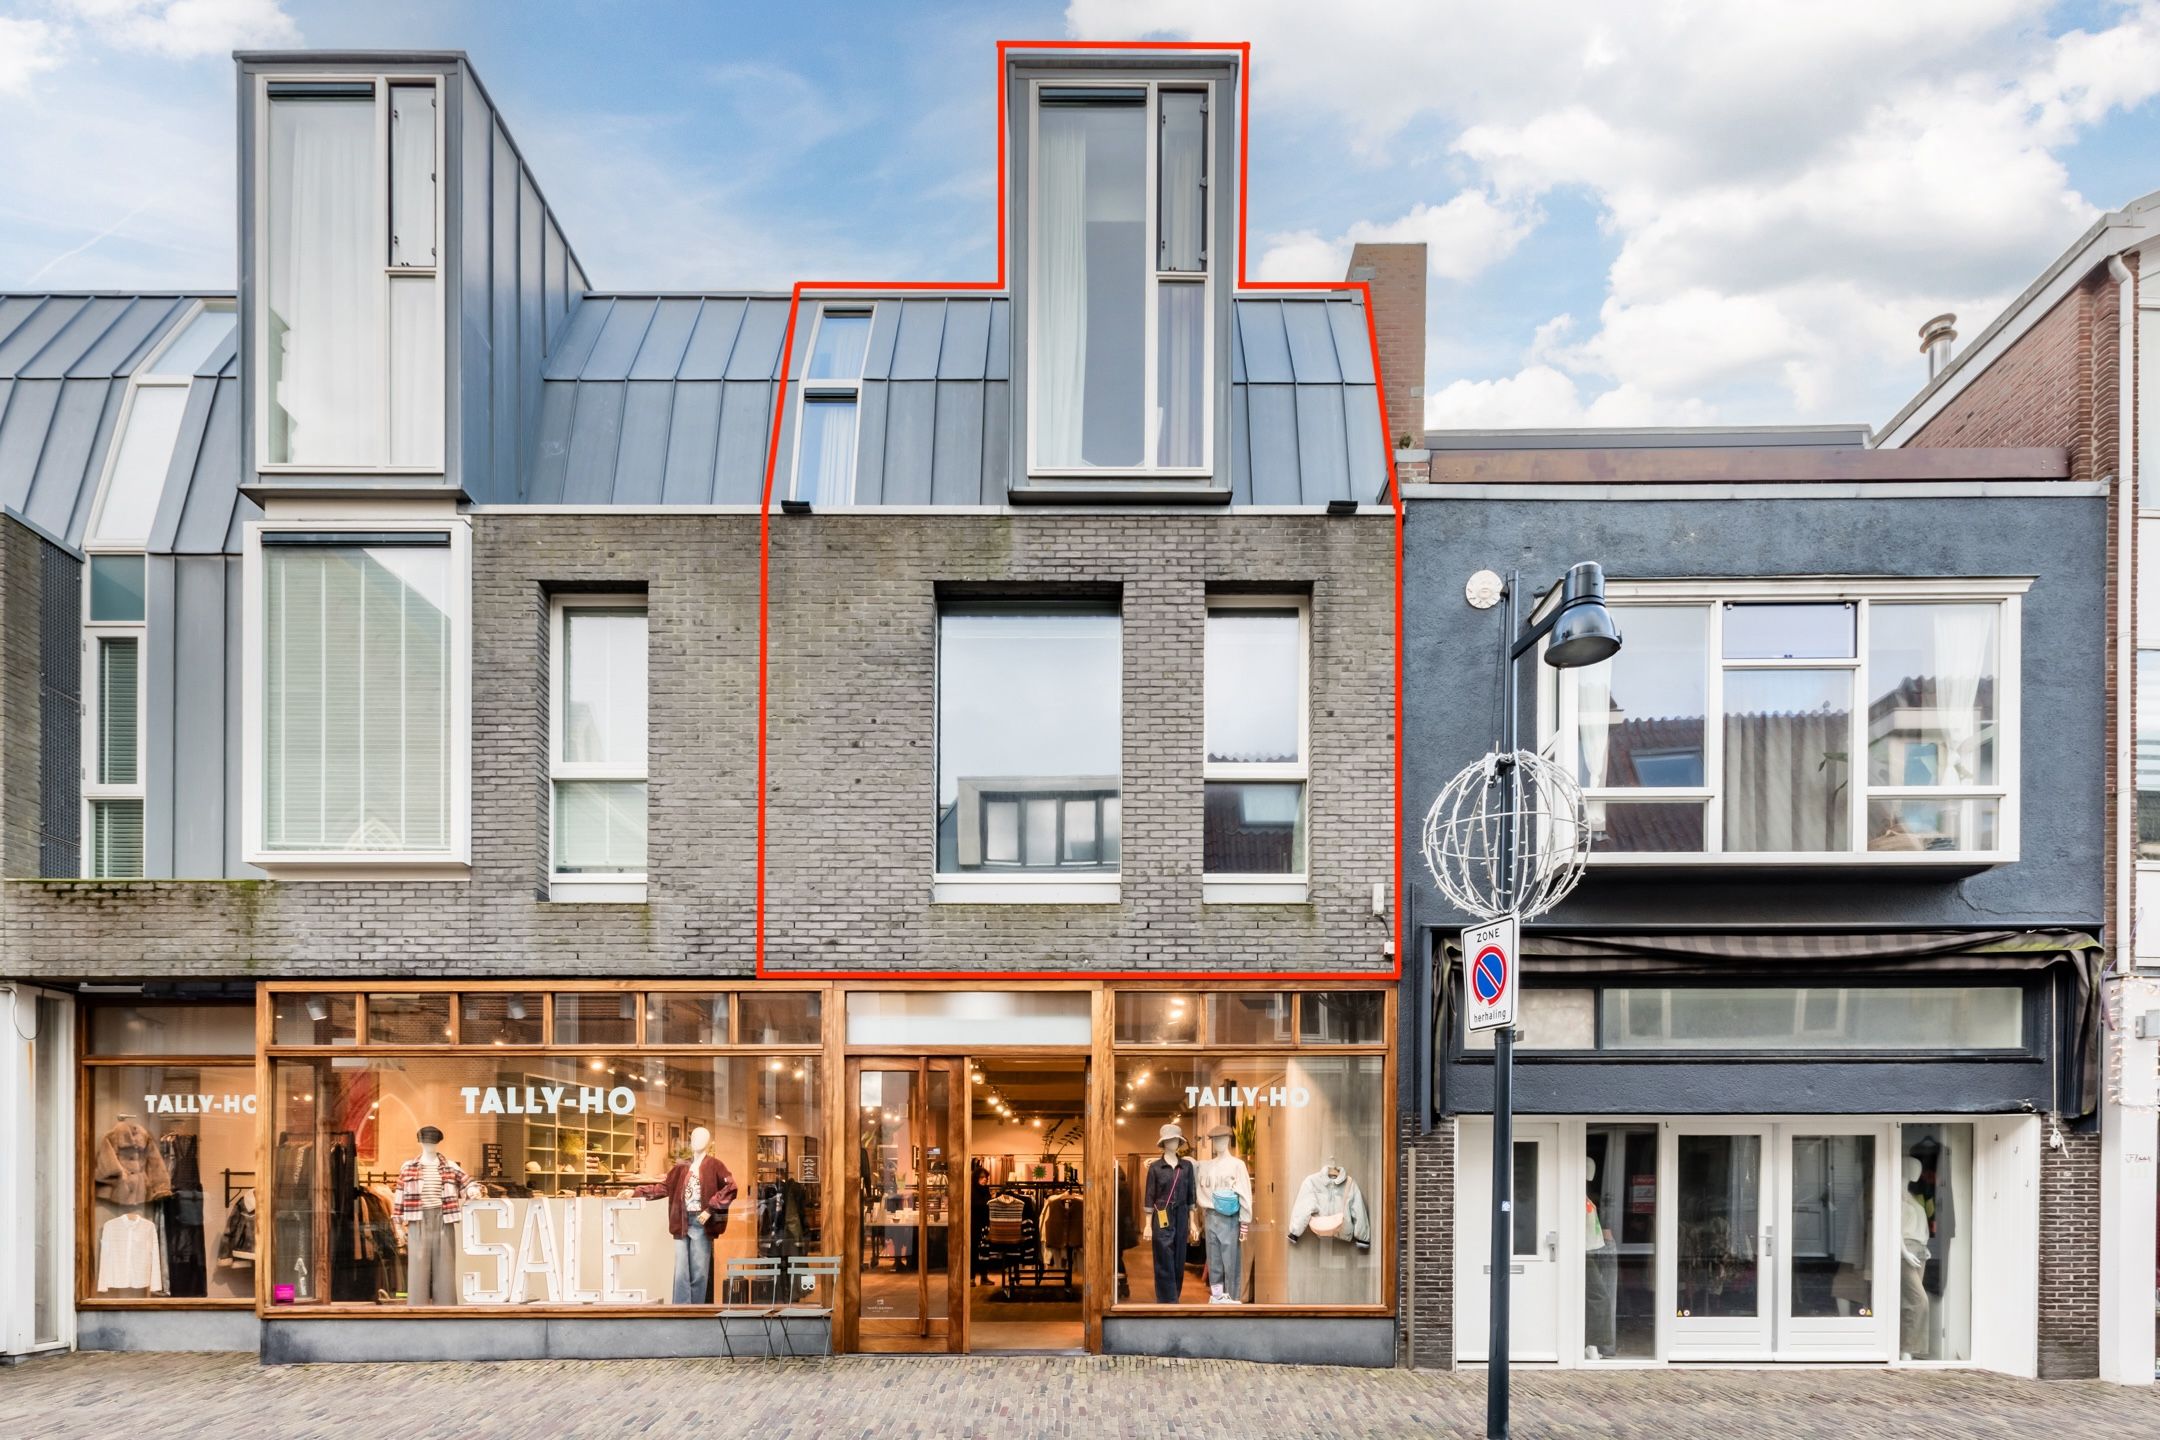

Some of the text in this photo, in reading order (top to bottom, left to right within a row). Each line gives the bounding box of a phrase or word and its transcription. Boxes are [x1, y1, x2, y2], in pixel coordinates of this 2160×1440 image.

[1476, 928, 1500, 942] ZONE
[1474, 1010, 1506, 1022] herhaling
[460, 1086, 636, 1114] TALLY-HO
[1185, 1086, 1310, 1108] TALLY-HO
[462, 1197, 647, 1303] SALE
